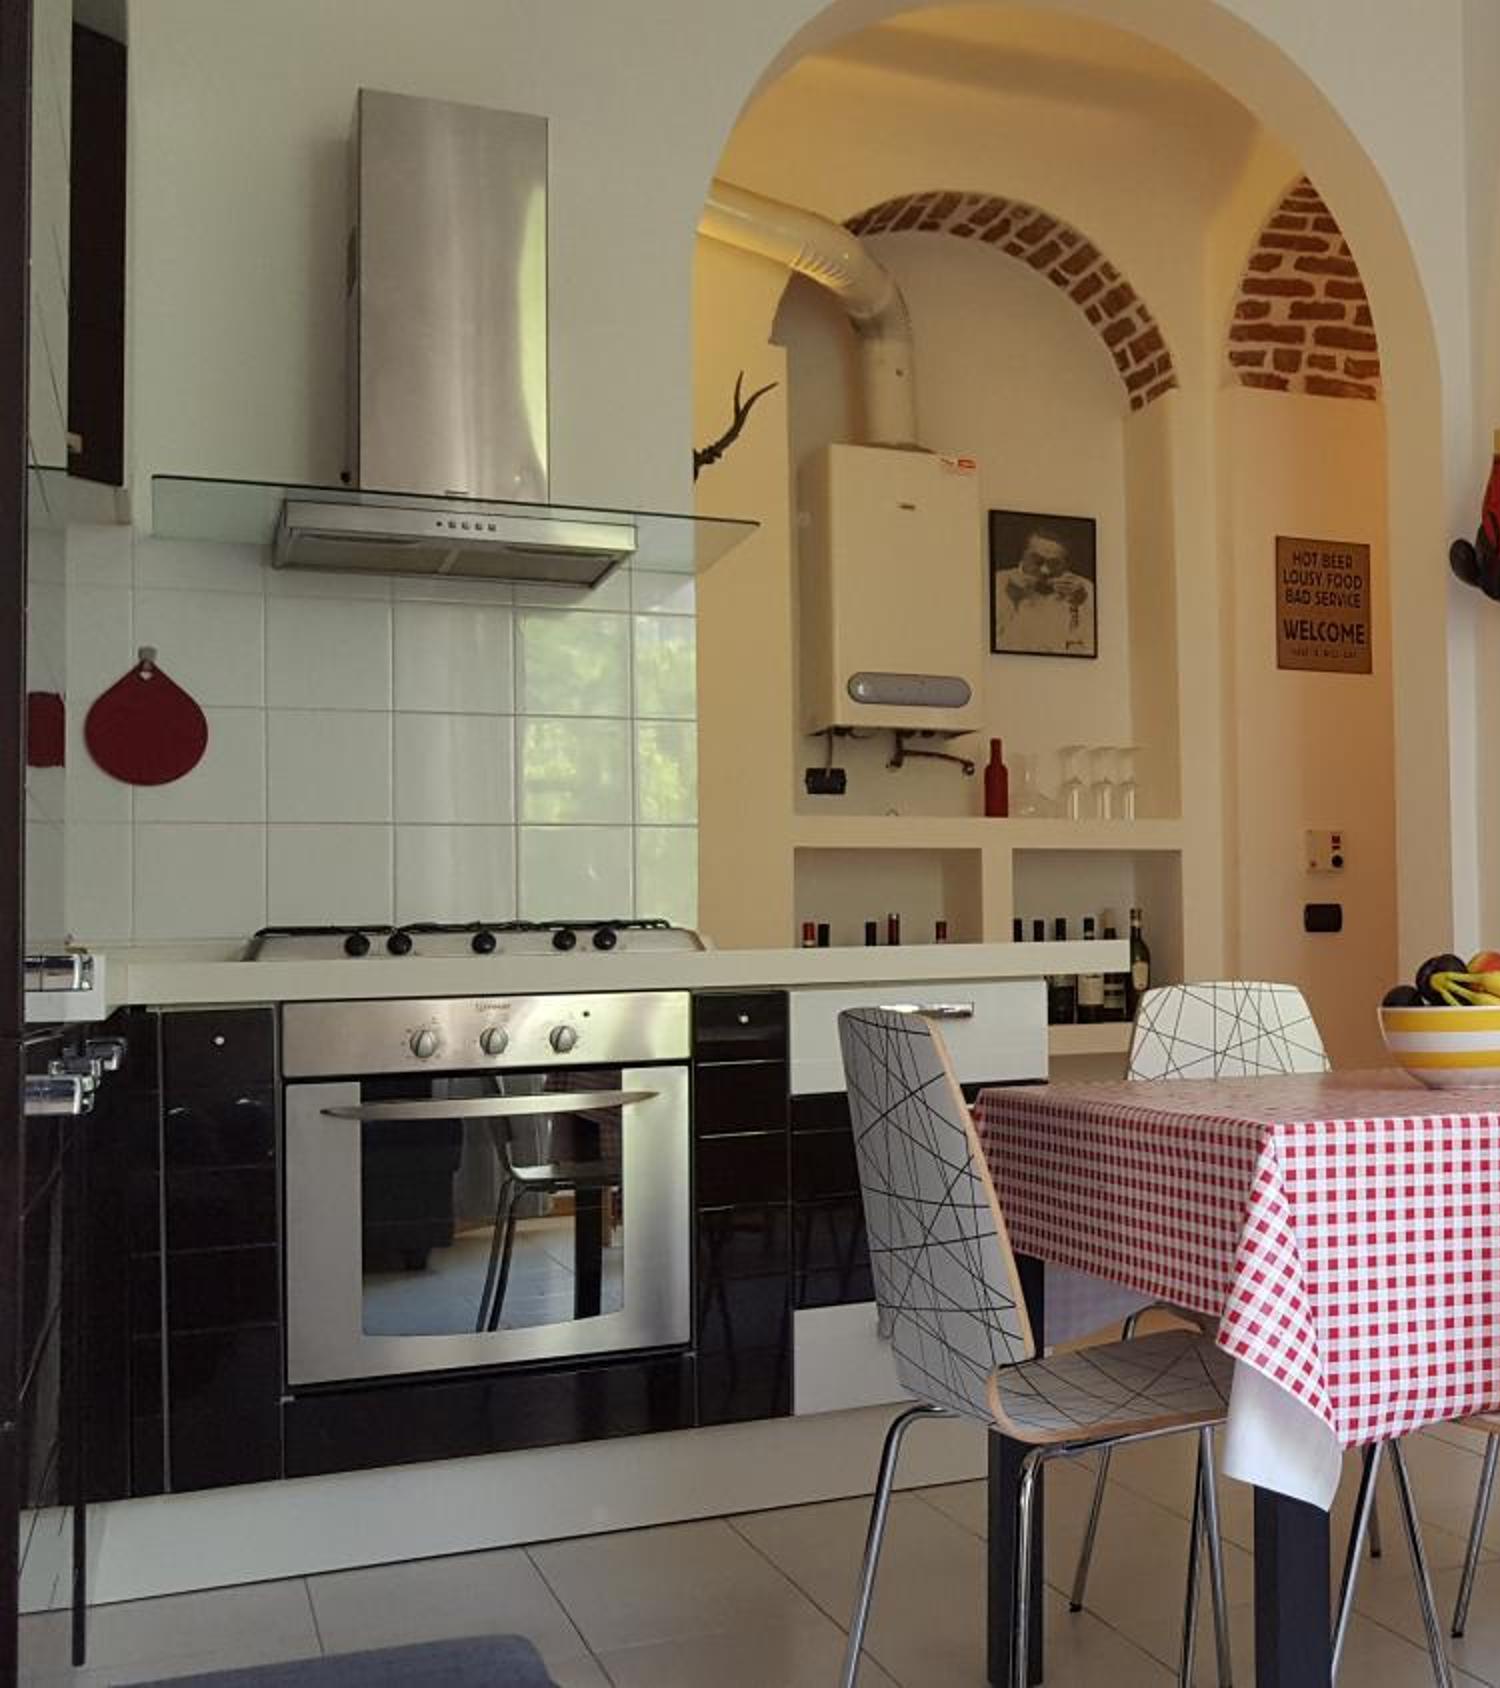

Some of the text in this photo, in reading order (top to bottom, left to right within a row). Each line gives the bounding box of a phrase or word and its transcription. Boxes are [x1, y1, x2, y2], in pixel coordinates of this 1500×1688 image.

[1292, 551, 1353, 569] HOT BEER
[1283, 568, 1363, 590] LOUSY FOOD
[1285, 588, 1361, 608] BAD SERVICE
[1283, 619, 1365, 645] WELCOME
